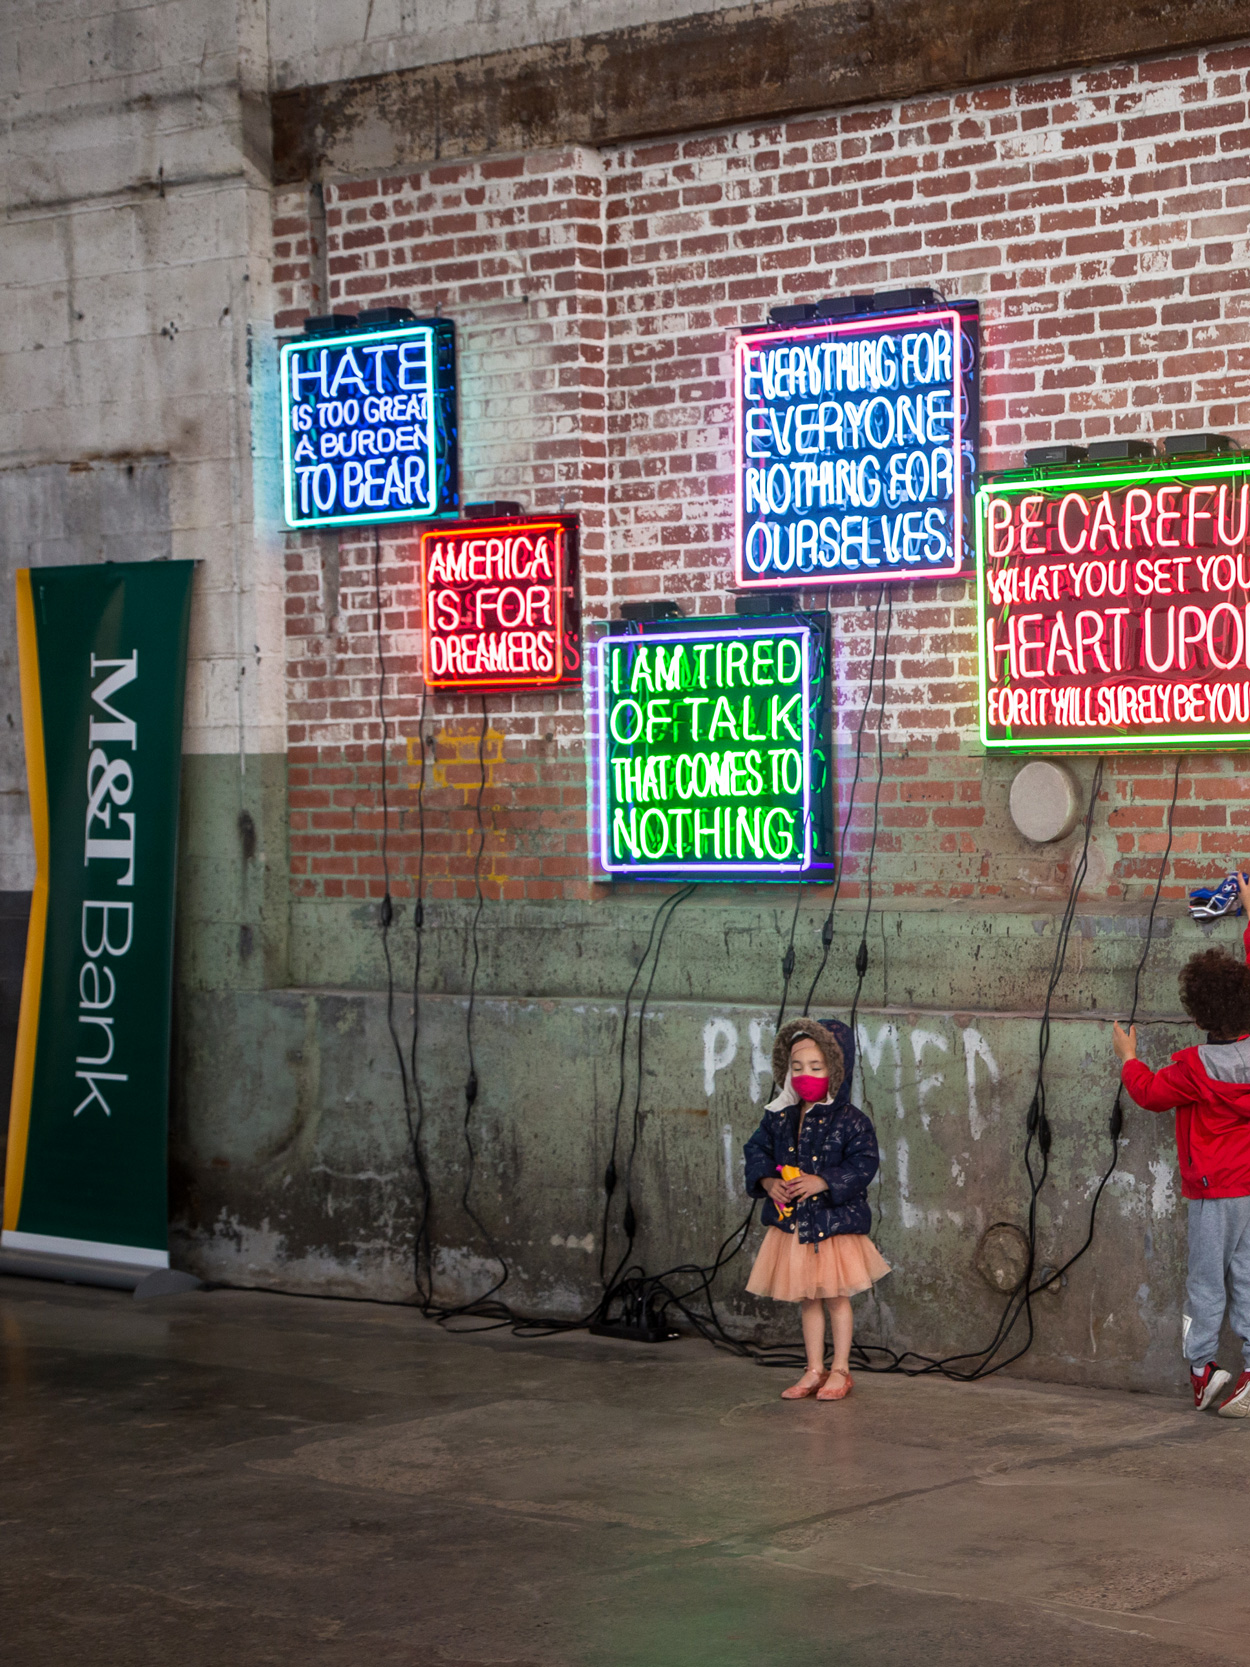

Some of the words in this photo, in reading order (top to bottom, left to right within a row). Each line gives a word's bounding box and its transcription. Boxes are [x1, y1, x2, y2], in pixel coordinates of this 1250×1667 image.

[292, 341, 430, 400] HATE
[744, 335, 895, 401] EVERYTHING
[901, 329, 951, 384] FOR
[292, 404, 312, 431] IS
[317, 399, 359, 427] TOO
[363, 393, 429, 423] GREAT
[746, 390, 954, 458] EVERYONE
[295, 434, 317, 461] A
[320, 424, 429, 458] BURDEN
[295, 463, 336, 514] TO
[746, 455, 880, 514] NOTHING
[889, 447, 953, 502] FOR
[746, 508, 954, 573] OURSELVES.
[987, 496, 1046, 557] BE
[427, 536, 553, 583] AMERICA
[987, 564, 1066, 605] WHAT
[1069, 559, 1127, 598] YOU
[1135, 558, 1191, 596] SET
[428, 589, 460, 631] IS
[475, 586, 553, 628] FOR
[430, 631, 553, 675] DREAMERS
[612, 648, 620, 694] I
[631, 644, 684, 693] AM
[693, 639, 801, 688] TIRED
[987, 608, 1130, 682] HEART
[610, 699, 671, 744] OF
[683, 693, 802, 742] TALK
[987, 688, 1030, 726] FOR
[1030, 688, 1050, 726] IT
[1051, 687, 1097, 726] WILL
[1099, 684, 1172, 726] SURELY
[1173, 684, 1206, 723] BE
[84, 649, 138, 886] M&T
[611, 755, 671, 803] THAT
[676, 749, 763, 799] COMES
[768, 749, 802, 795] TO
[613, 806, 805, 859] NOTHING.
[73, 901, 133, 1117] Bank
